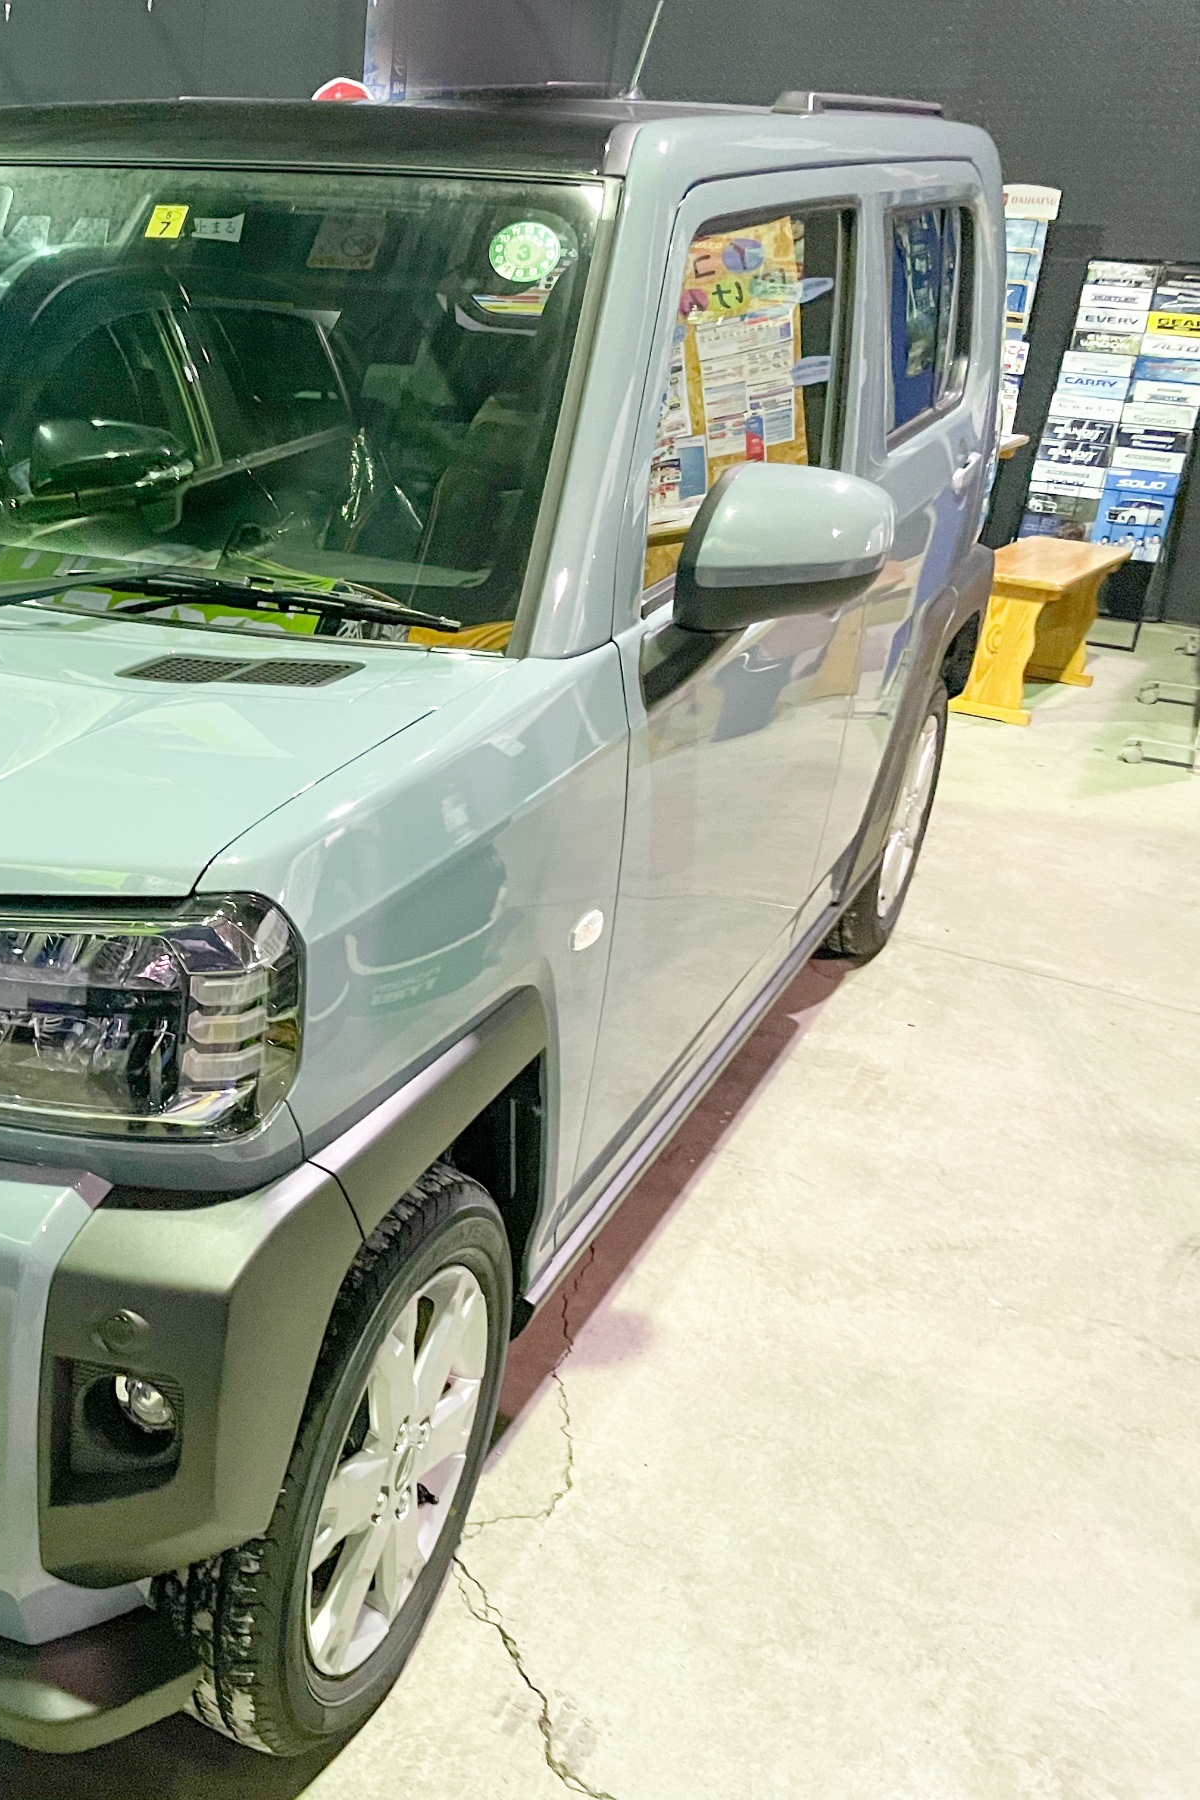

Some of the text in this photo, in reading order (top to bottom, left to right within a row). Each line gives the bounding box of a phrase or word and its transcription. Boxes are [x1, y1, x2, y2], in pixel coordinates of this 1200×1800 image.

[159, 221, 171, 235] 7
[516, 244, 531, 261] 3
[1085, 315, 1139, 325] EVERY
[1065, 377, 1117, 387] CARRY
[1054, 426, 1104, 441] BANDIT
[1047, 447, 1098, 464] BANDIT
